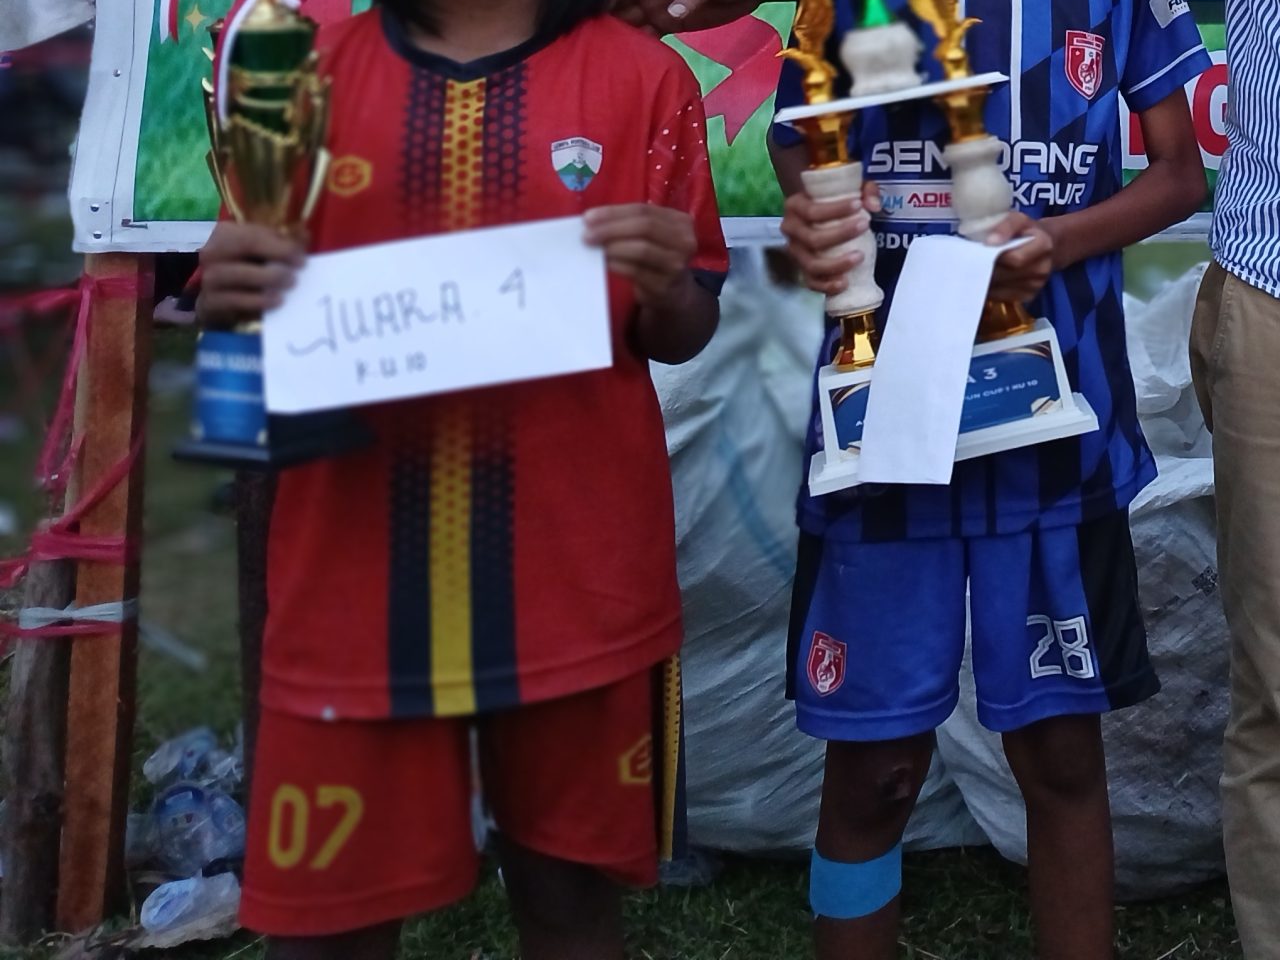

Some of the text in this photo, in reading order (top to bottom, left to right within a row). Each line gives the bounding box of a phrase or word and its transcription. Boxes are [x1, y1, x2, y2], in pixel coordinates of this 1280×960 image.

[983, 367, 998, 380] 3
[1026, 614, 1095, 680] 28
[267, 783, 365, 870] 07
